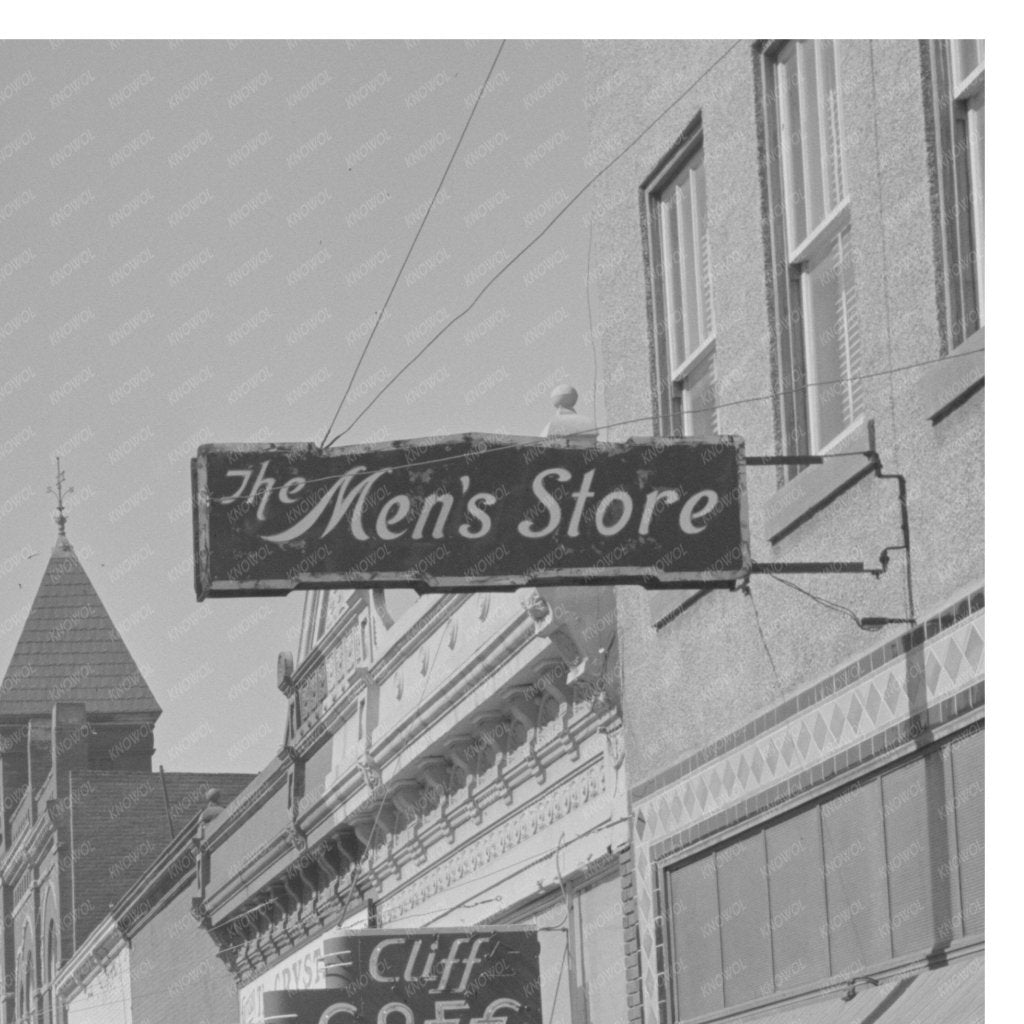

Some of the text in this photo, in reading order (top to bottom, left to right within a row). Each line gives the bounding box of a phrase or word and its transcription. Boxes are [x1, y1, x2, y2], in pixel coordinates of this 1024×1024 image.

[221, 460, 719, 542] The Men's Store
[368, 936, 493, 994] Cliff
